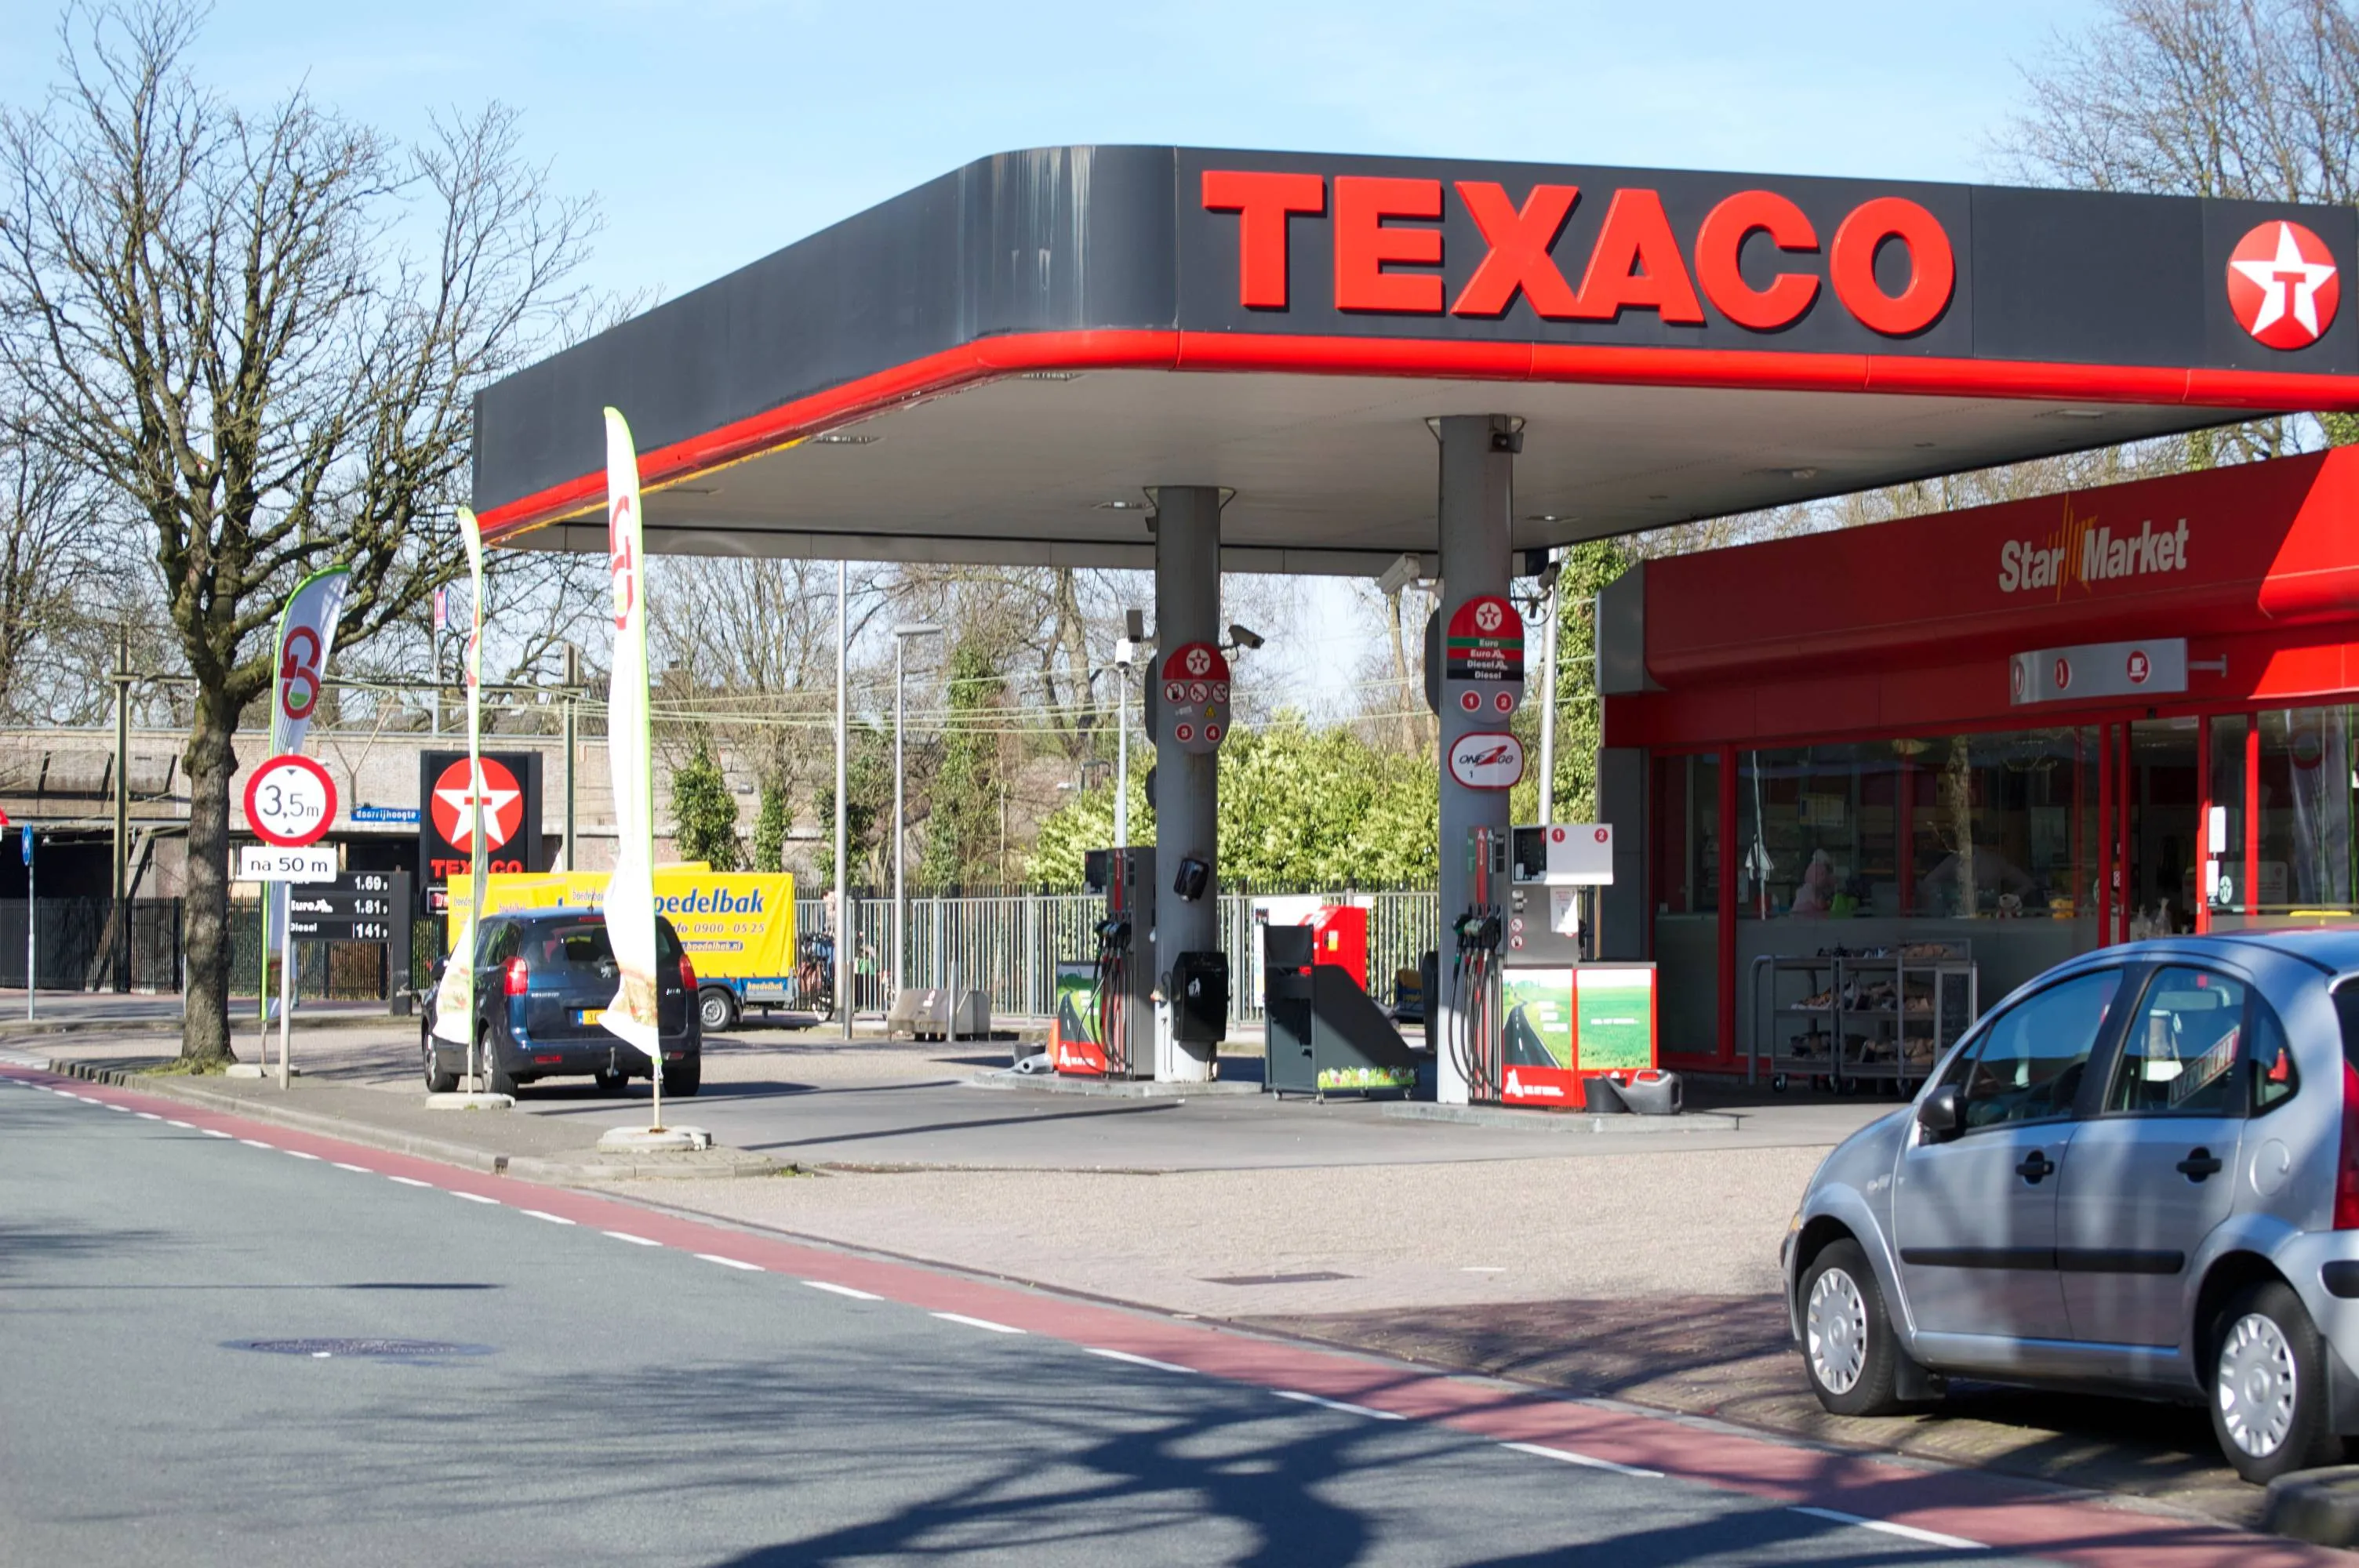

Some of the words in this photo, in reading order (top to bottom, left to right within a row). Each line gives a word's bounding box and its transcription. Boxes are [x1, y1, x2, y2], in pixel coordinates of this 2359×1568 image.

[1202, 170, 1956, 336] TEXACO
[1999, 539, 2065, 593] Star
[2081, 517, 2190, 581] Market
[1479, 638, 1499, 648] Euro
[1470, 649, 1491, 658] Euro
[1467, 659, 1495, 669] Diesel
[1474, 670, 1502, 680] Diesel
[356, 809, 416, 821] doorrijhoogte
[1556, 831, 1561, 841] 1
[1598, 831, 1605, 841] 2
[250, 859, 271, 873] na
[278, 858, 304, 873] 50
[311, 860, 329, 873] m
[431, 859, 524, 879] TEXCO
[653, 887, 765, 914] oedelbak
[694, 923, 725, 934] 0900
